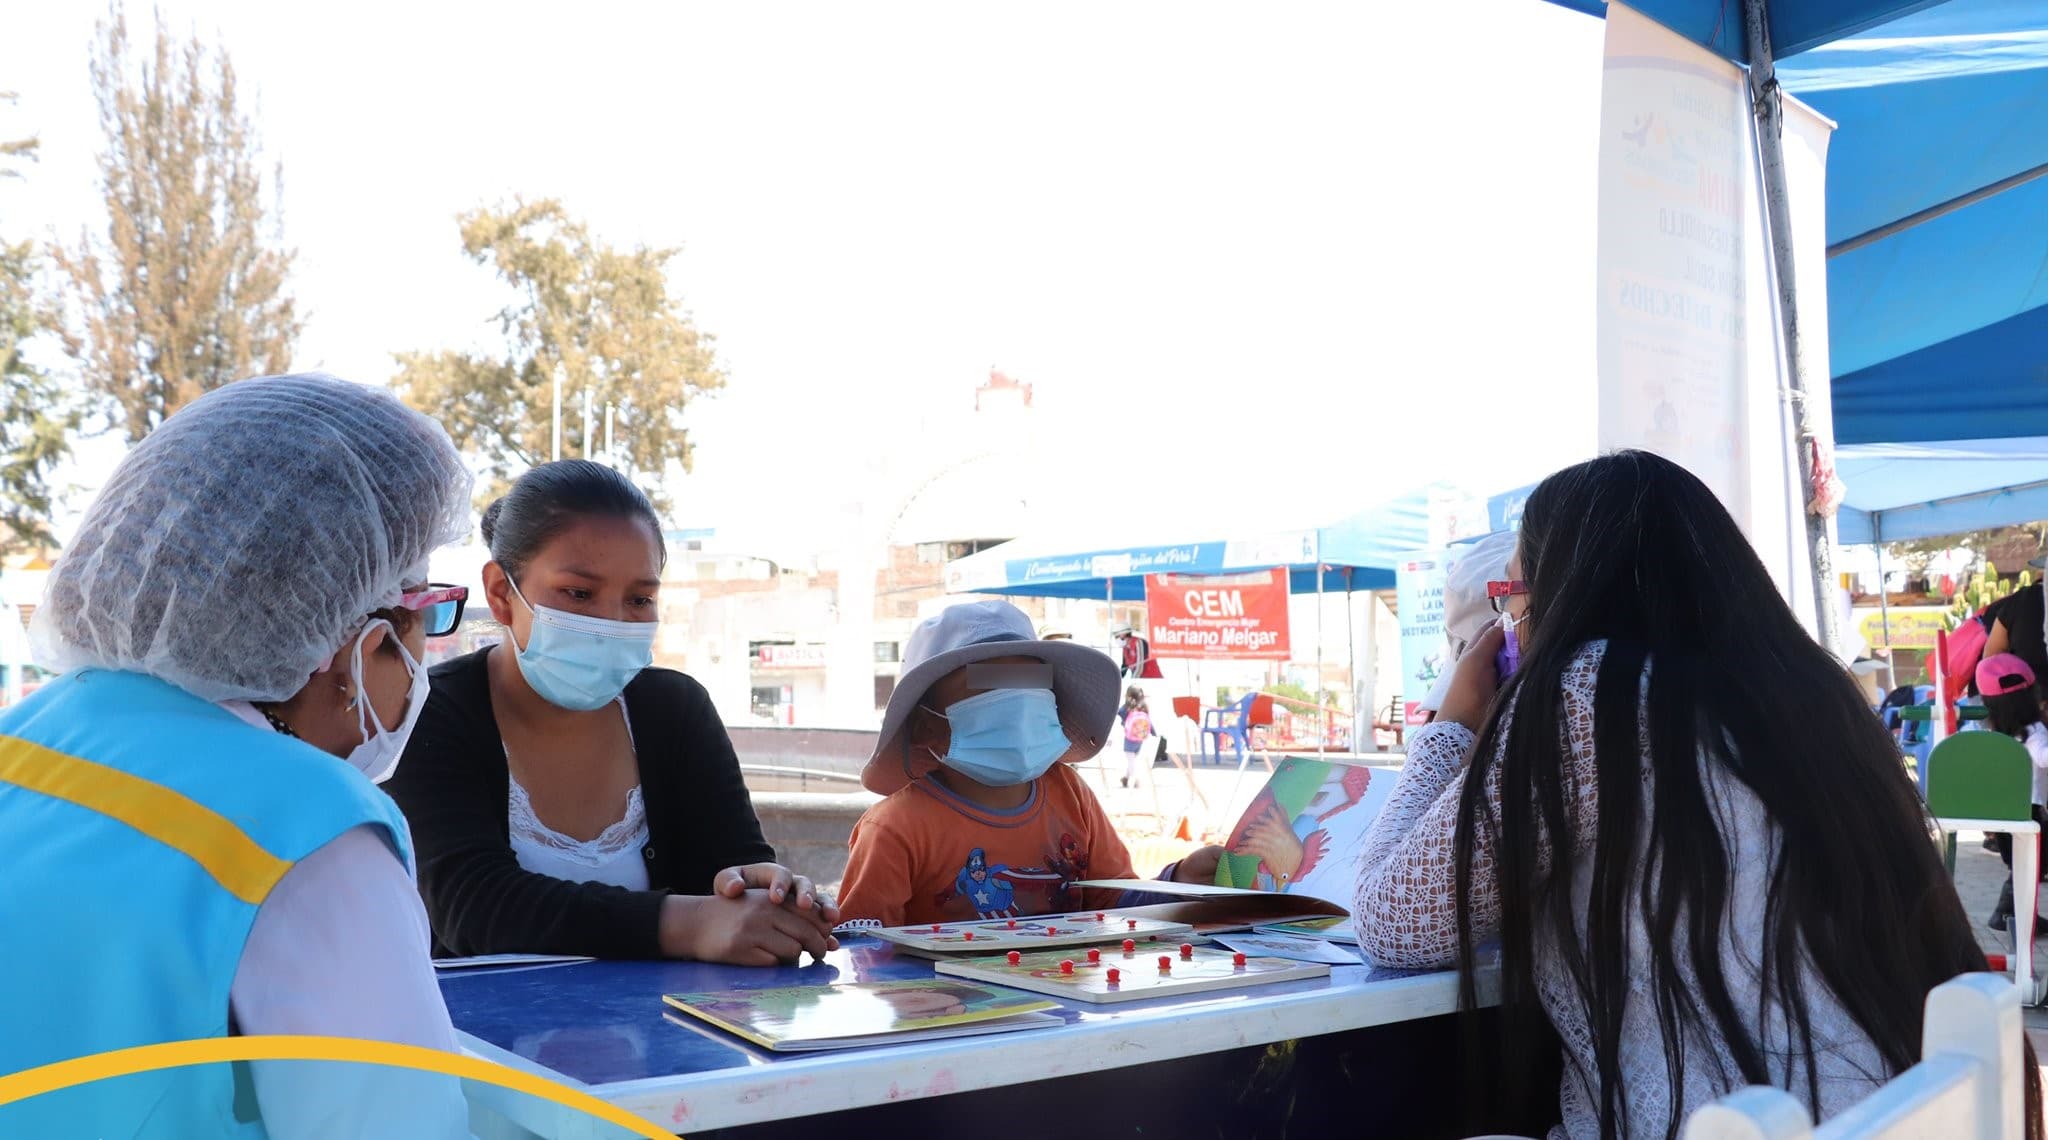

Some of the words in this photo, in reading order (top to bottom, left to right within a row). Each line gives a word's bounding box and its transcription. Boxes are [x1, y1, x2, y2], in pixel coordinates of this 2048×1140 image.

[1184, 589, 1244, 616] CEM
[1153, 626, 1219, 645] Mariano
[1221, 628, 1278, 650] Melgar
